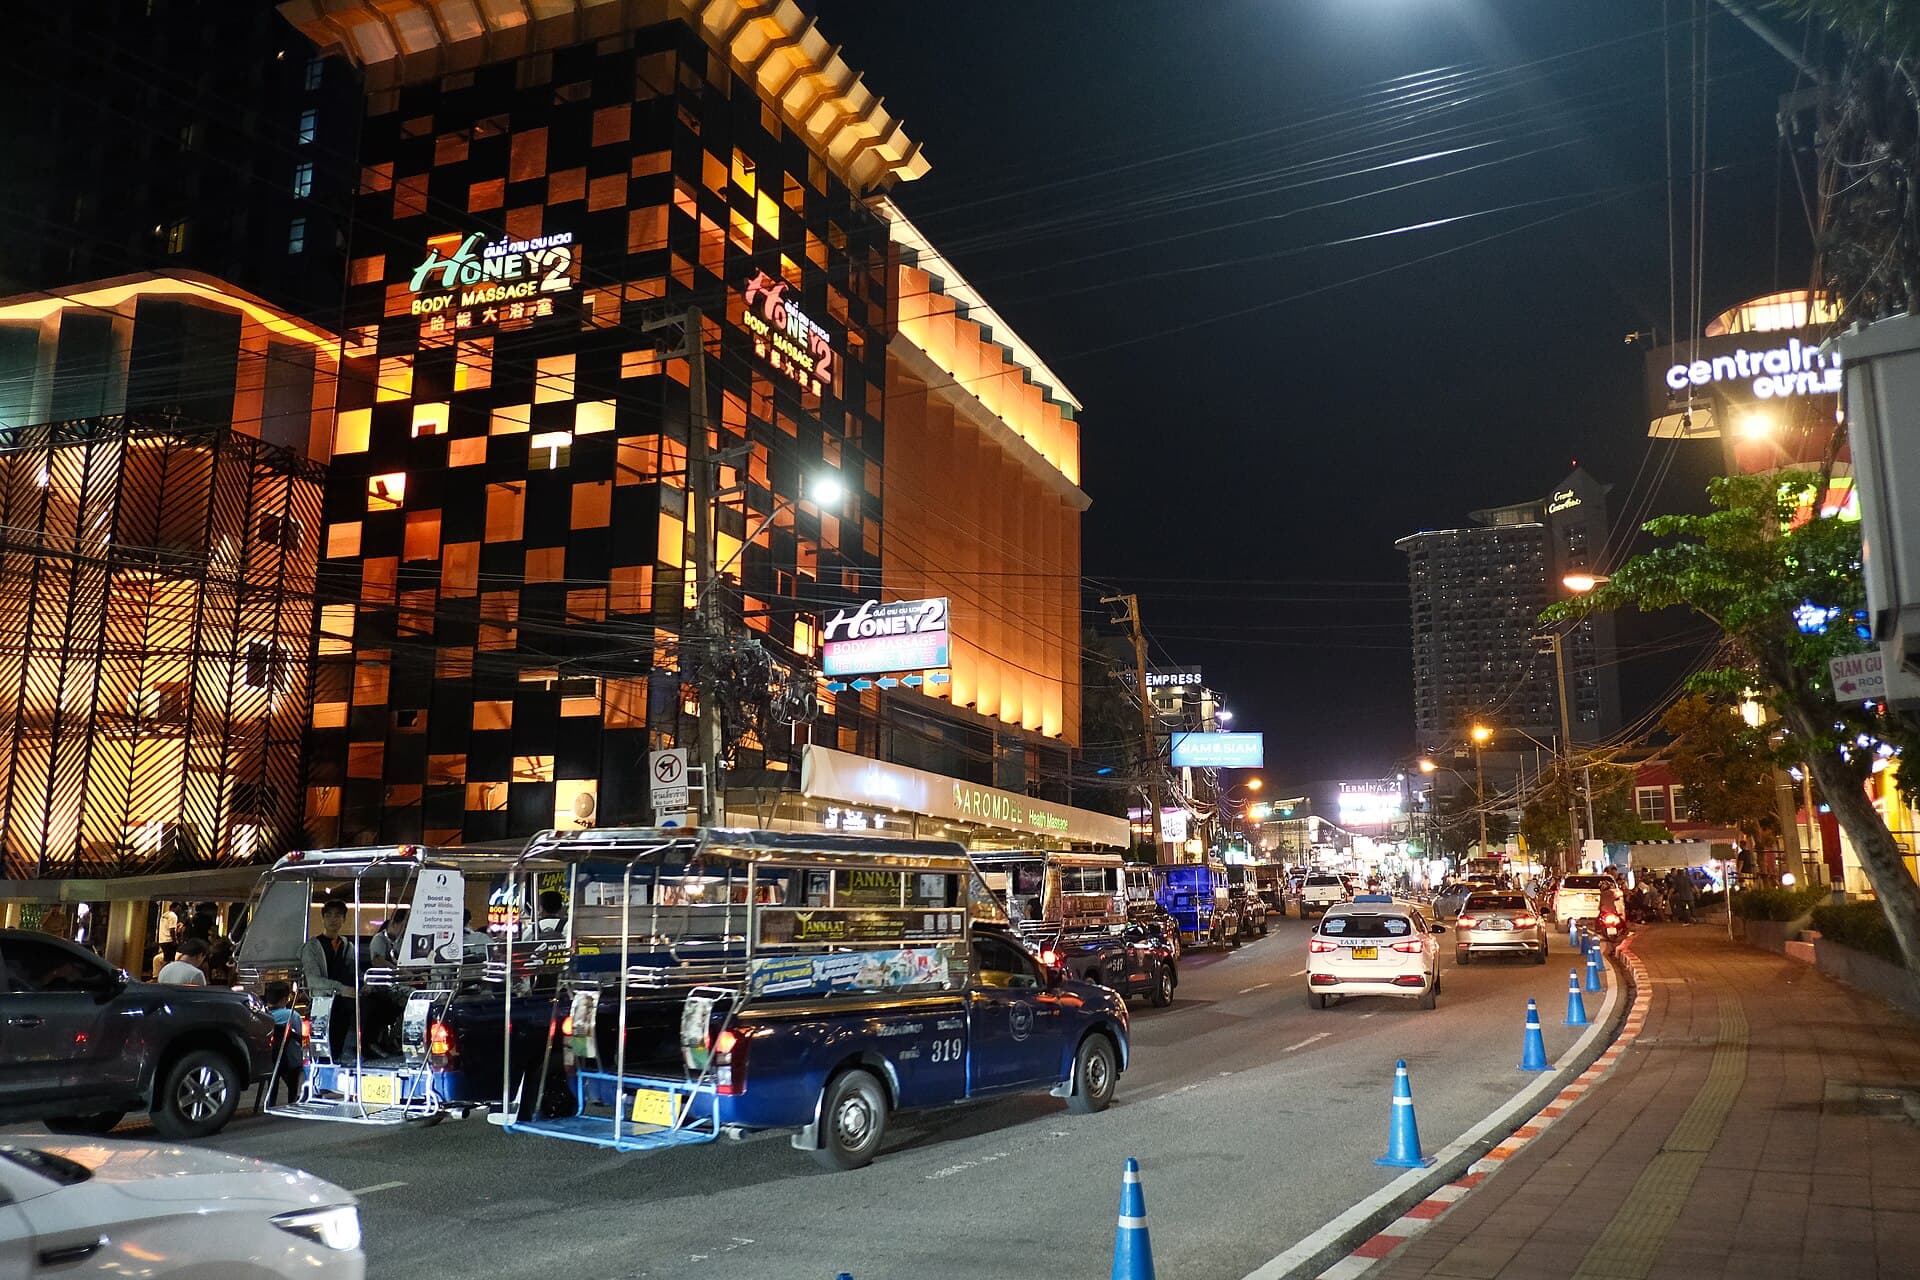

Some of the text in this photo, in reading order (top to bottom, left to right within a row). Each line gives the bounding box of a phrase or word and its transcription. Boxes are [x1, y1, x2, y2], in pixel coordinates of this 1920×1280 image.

[412, 281, 537, 315] BODY MASSAGE
[833, 634, 936, 656] BODY MASSAGE
[1146, 673, 1201, 686] EMPRESS
[1833, 659, 1862, 680] SIAM
[1389, 782, 1401, 792] 21
[963, 789, 1022, 824] AROMDEE
[1029, 809, 1069, 831] Health Massage
[931, 1038, 962, 1063] 319
